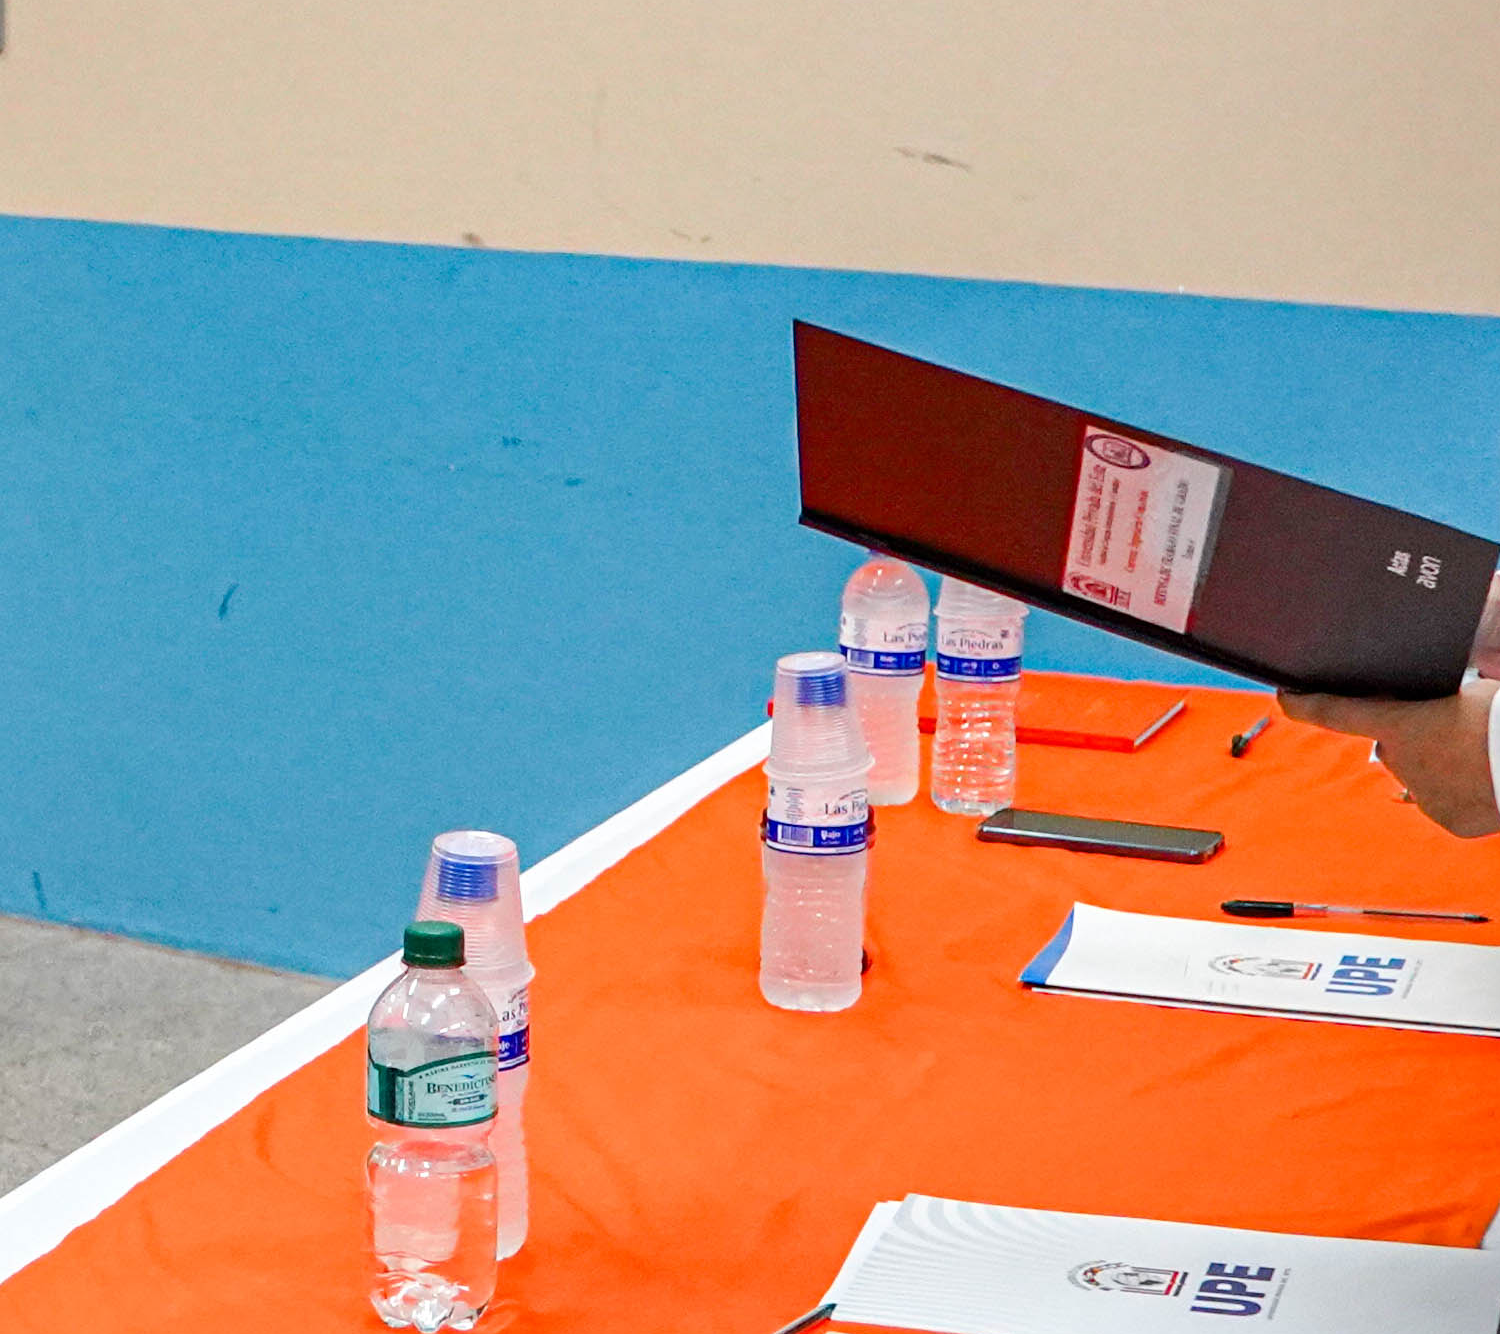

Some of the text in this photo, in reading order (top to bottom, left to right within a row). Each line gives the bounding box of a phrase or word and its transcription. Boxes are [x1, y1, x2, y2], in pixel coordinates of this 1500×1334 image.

[960, 637, 1004, 650] Piedras
[1325, 955, 1405, 996] UPE
[498, 1008, 516, 1022] as
[1190, 1262, 1275, 1317] UPE
